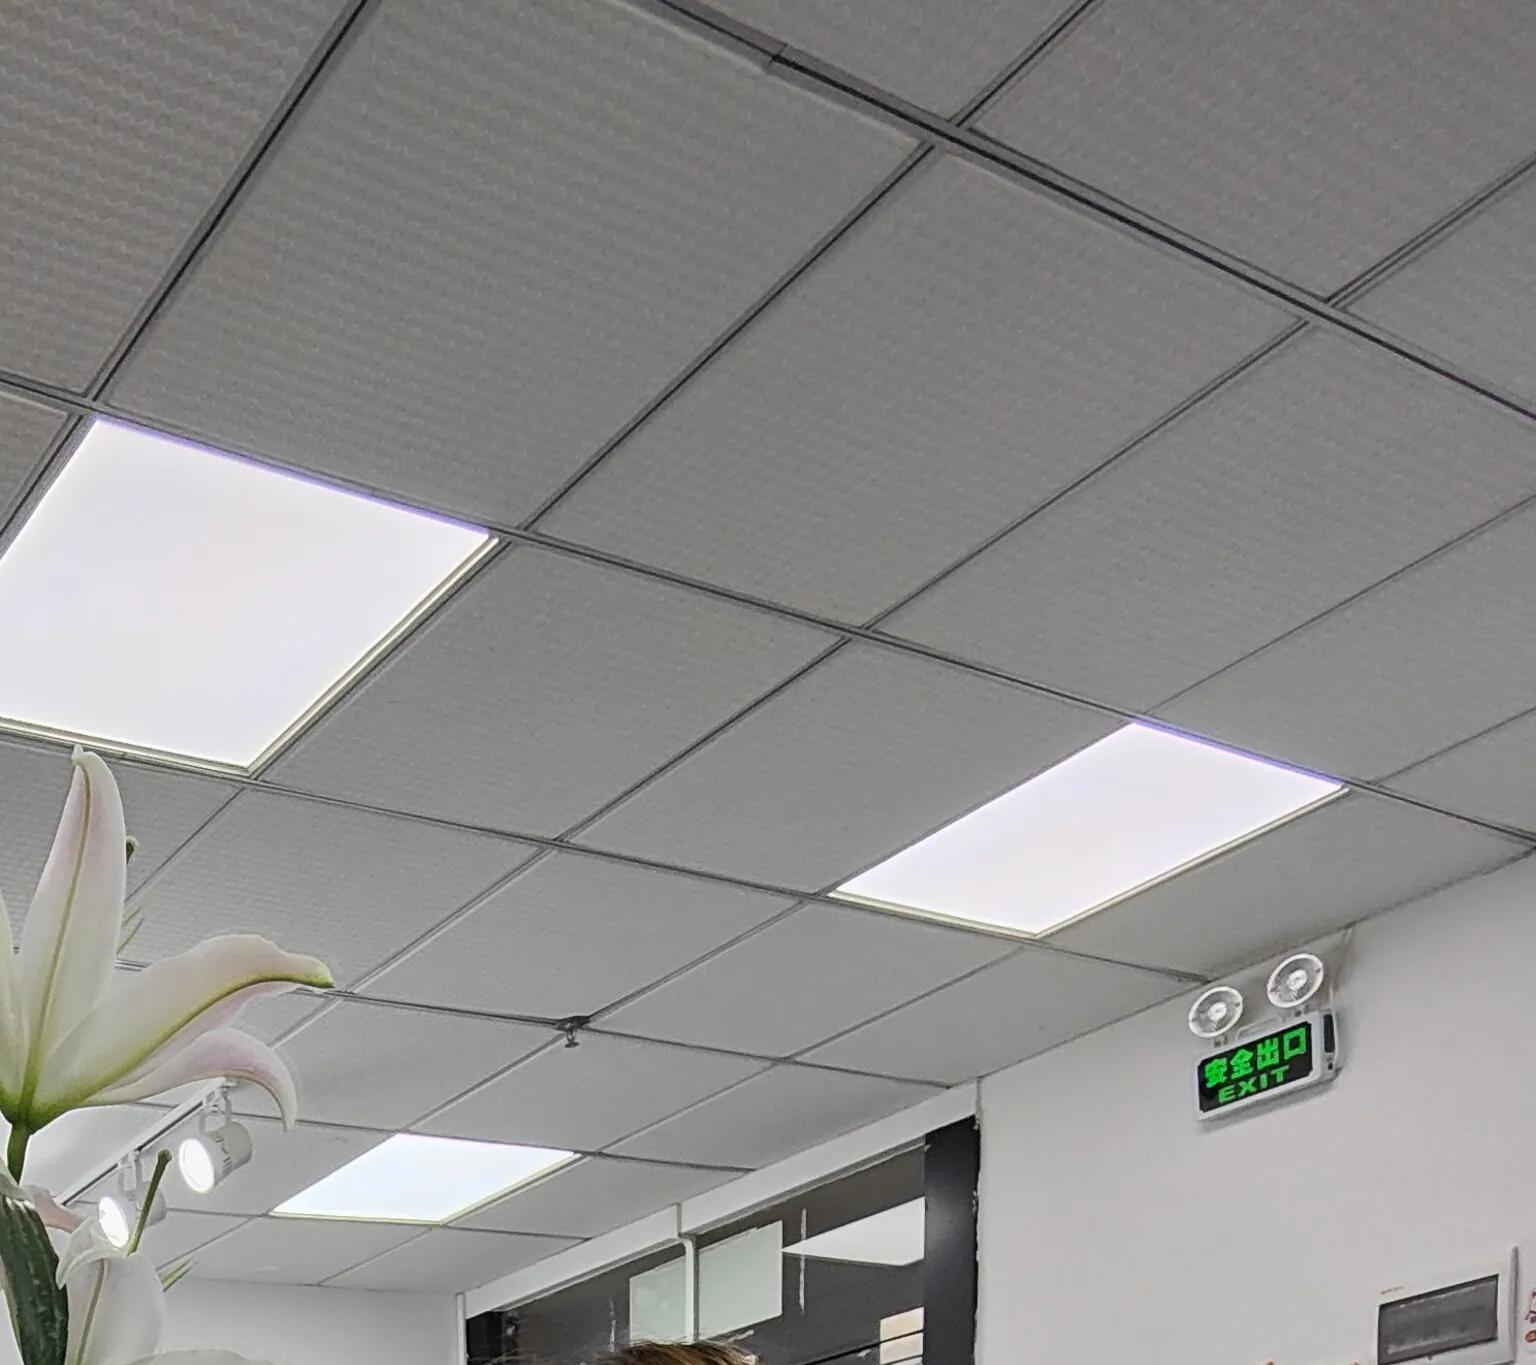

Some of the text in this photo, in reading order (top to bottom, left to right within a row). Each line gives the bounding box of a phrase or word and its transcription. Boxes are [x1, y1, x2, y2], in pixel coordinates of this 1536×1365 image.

[1204, 1026, 1307, 1089] 安全出口
[1218, 1064, 1290, 1104] EXIT
